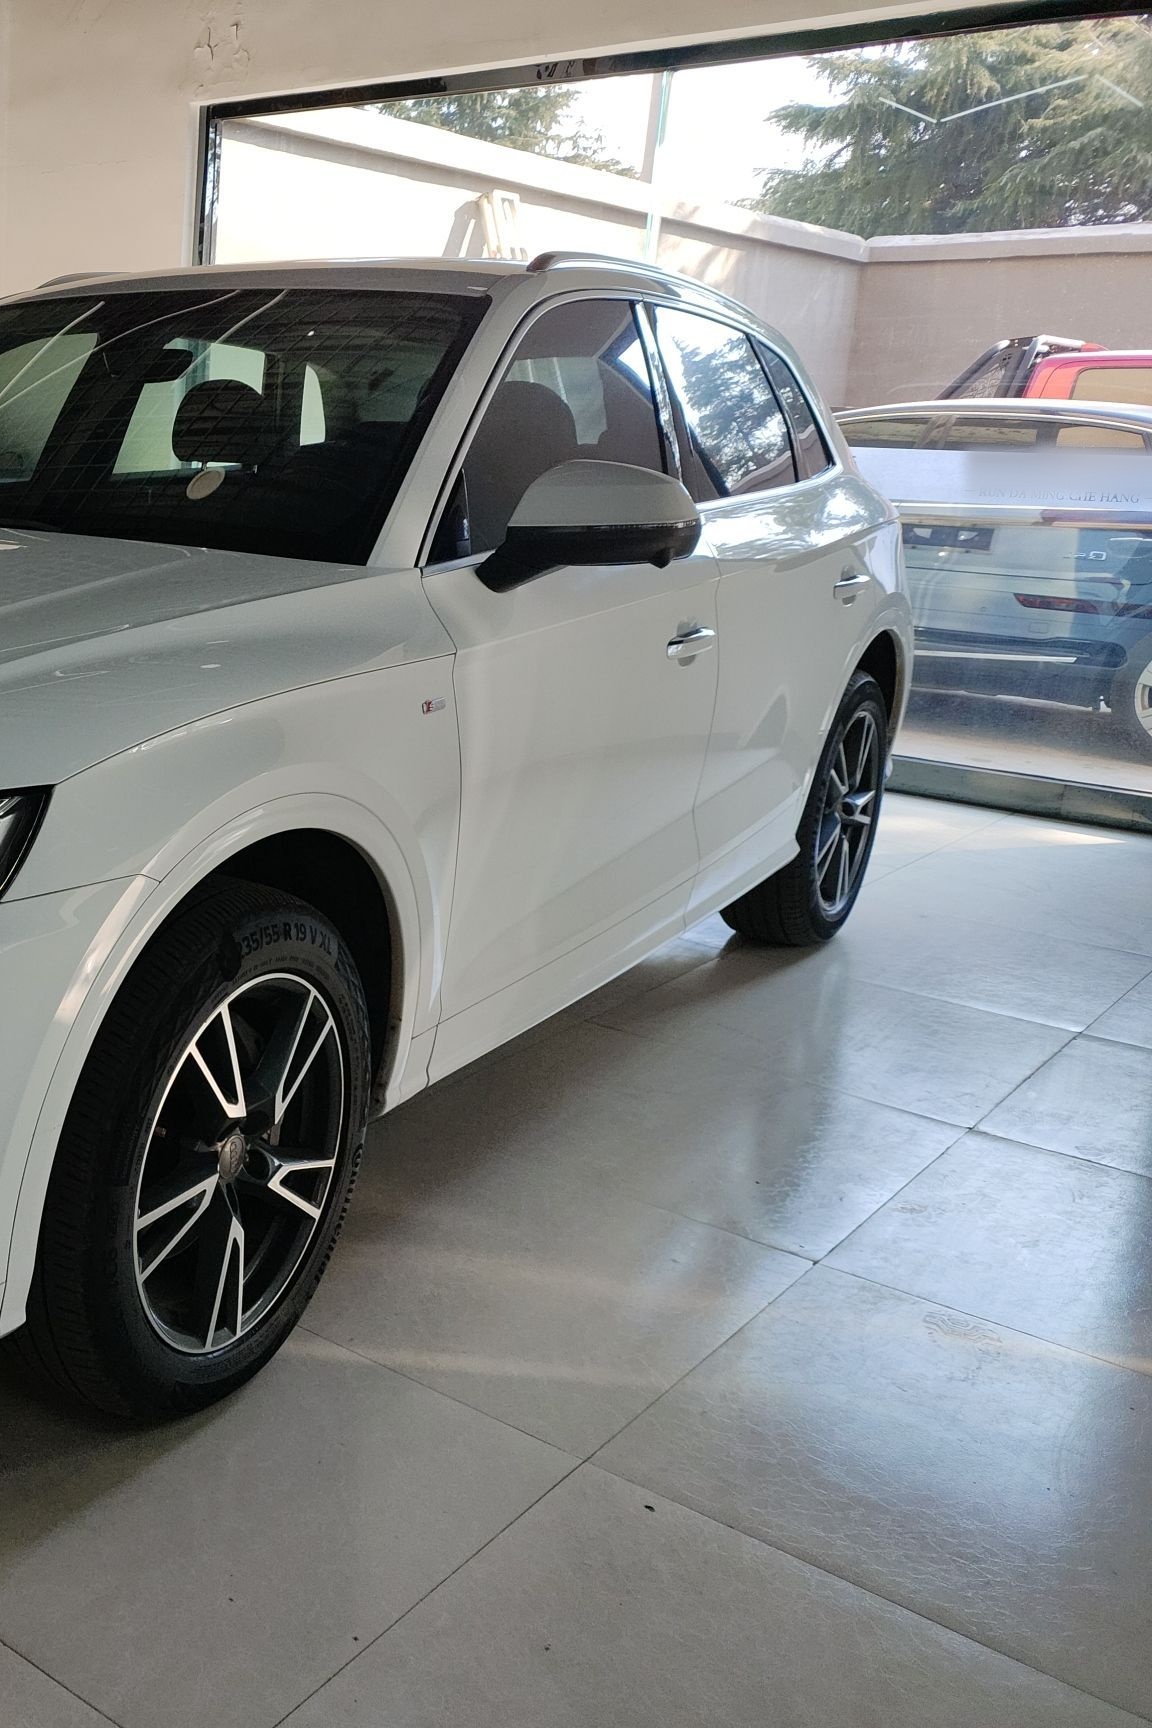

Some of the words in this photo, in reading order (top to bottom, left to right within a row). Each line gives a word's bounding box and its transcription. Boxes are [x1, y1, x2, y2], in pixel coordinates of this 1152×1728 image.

[1100, 492, 1140, 503] HANG
[239, 923, 280, 956] 35/55
[294, 921, 308, 942] 19
